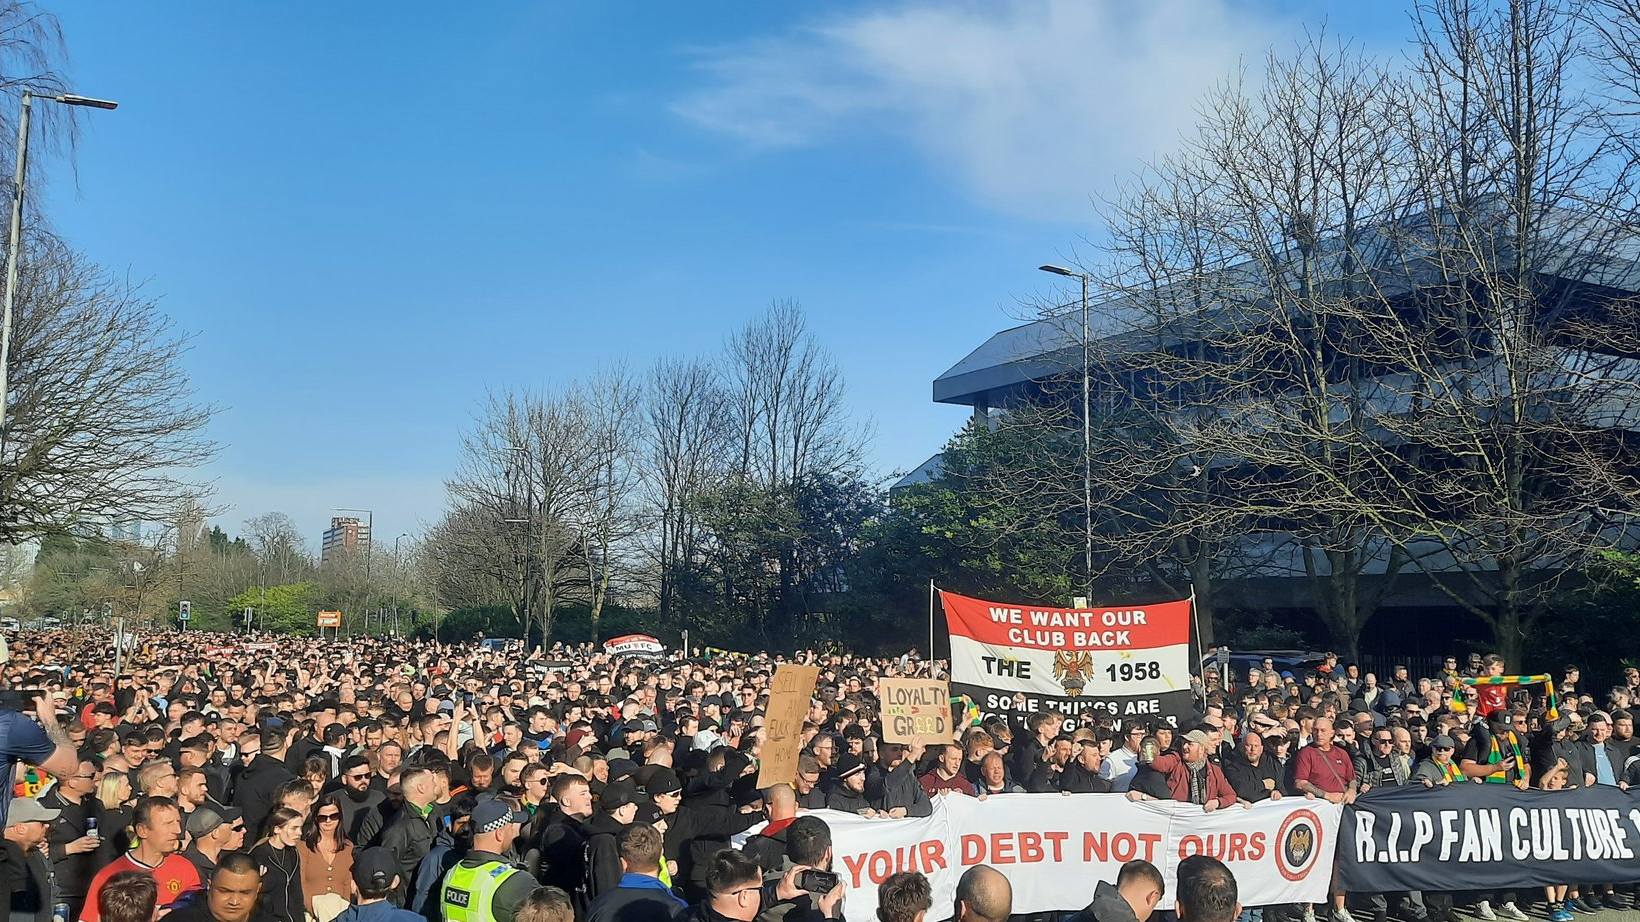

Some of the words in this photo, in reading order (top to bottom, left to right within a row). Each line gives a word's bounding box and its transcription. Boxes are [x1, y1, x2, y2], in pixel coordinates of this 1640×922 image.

[989, 607, 1023, 624] WE
[1030, 610, 1094, 627] WANT
[1101, 610, 1147, 626] OUR
[1008, 628, 1066, 647] CLUB
[1073, 630, 1131, 647] BACK
[982, 656, 1031, 679] THE
[1105, 661, 1161, 682] 1958
[887, 686, 946, 706] LOYALTY
[987, 694, 1039, 713] SOME
[1124, 699, 1160, 715] ARE
[1439, 808, 1503, 862] FAN
[1509, 807, 1635, 861] CULTURE
[842, 839, 947, 888] YOUR
[960, 832, 1069, 865] DEBT
[1083, 832, 1162, 862] NOT
[1178, 832, 1266, 861] OURS
[447, 890, 468, 904] POLICE
